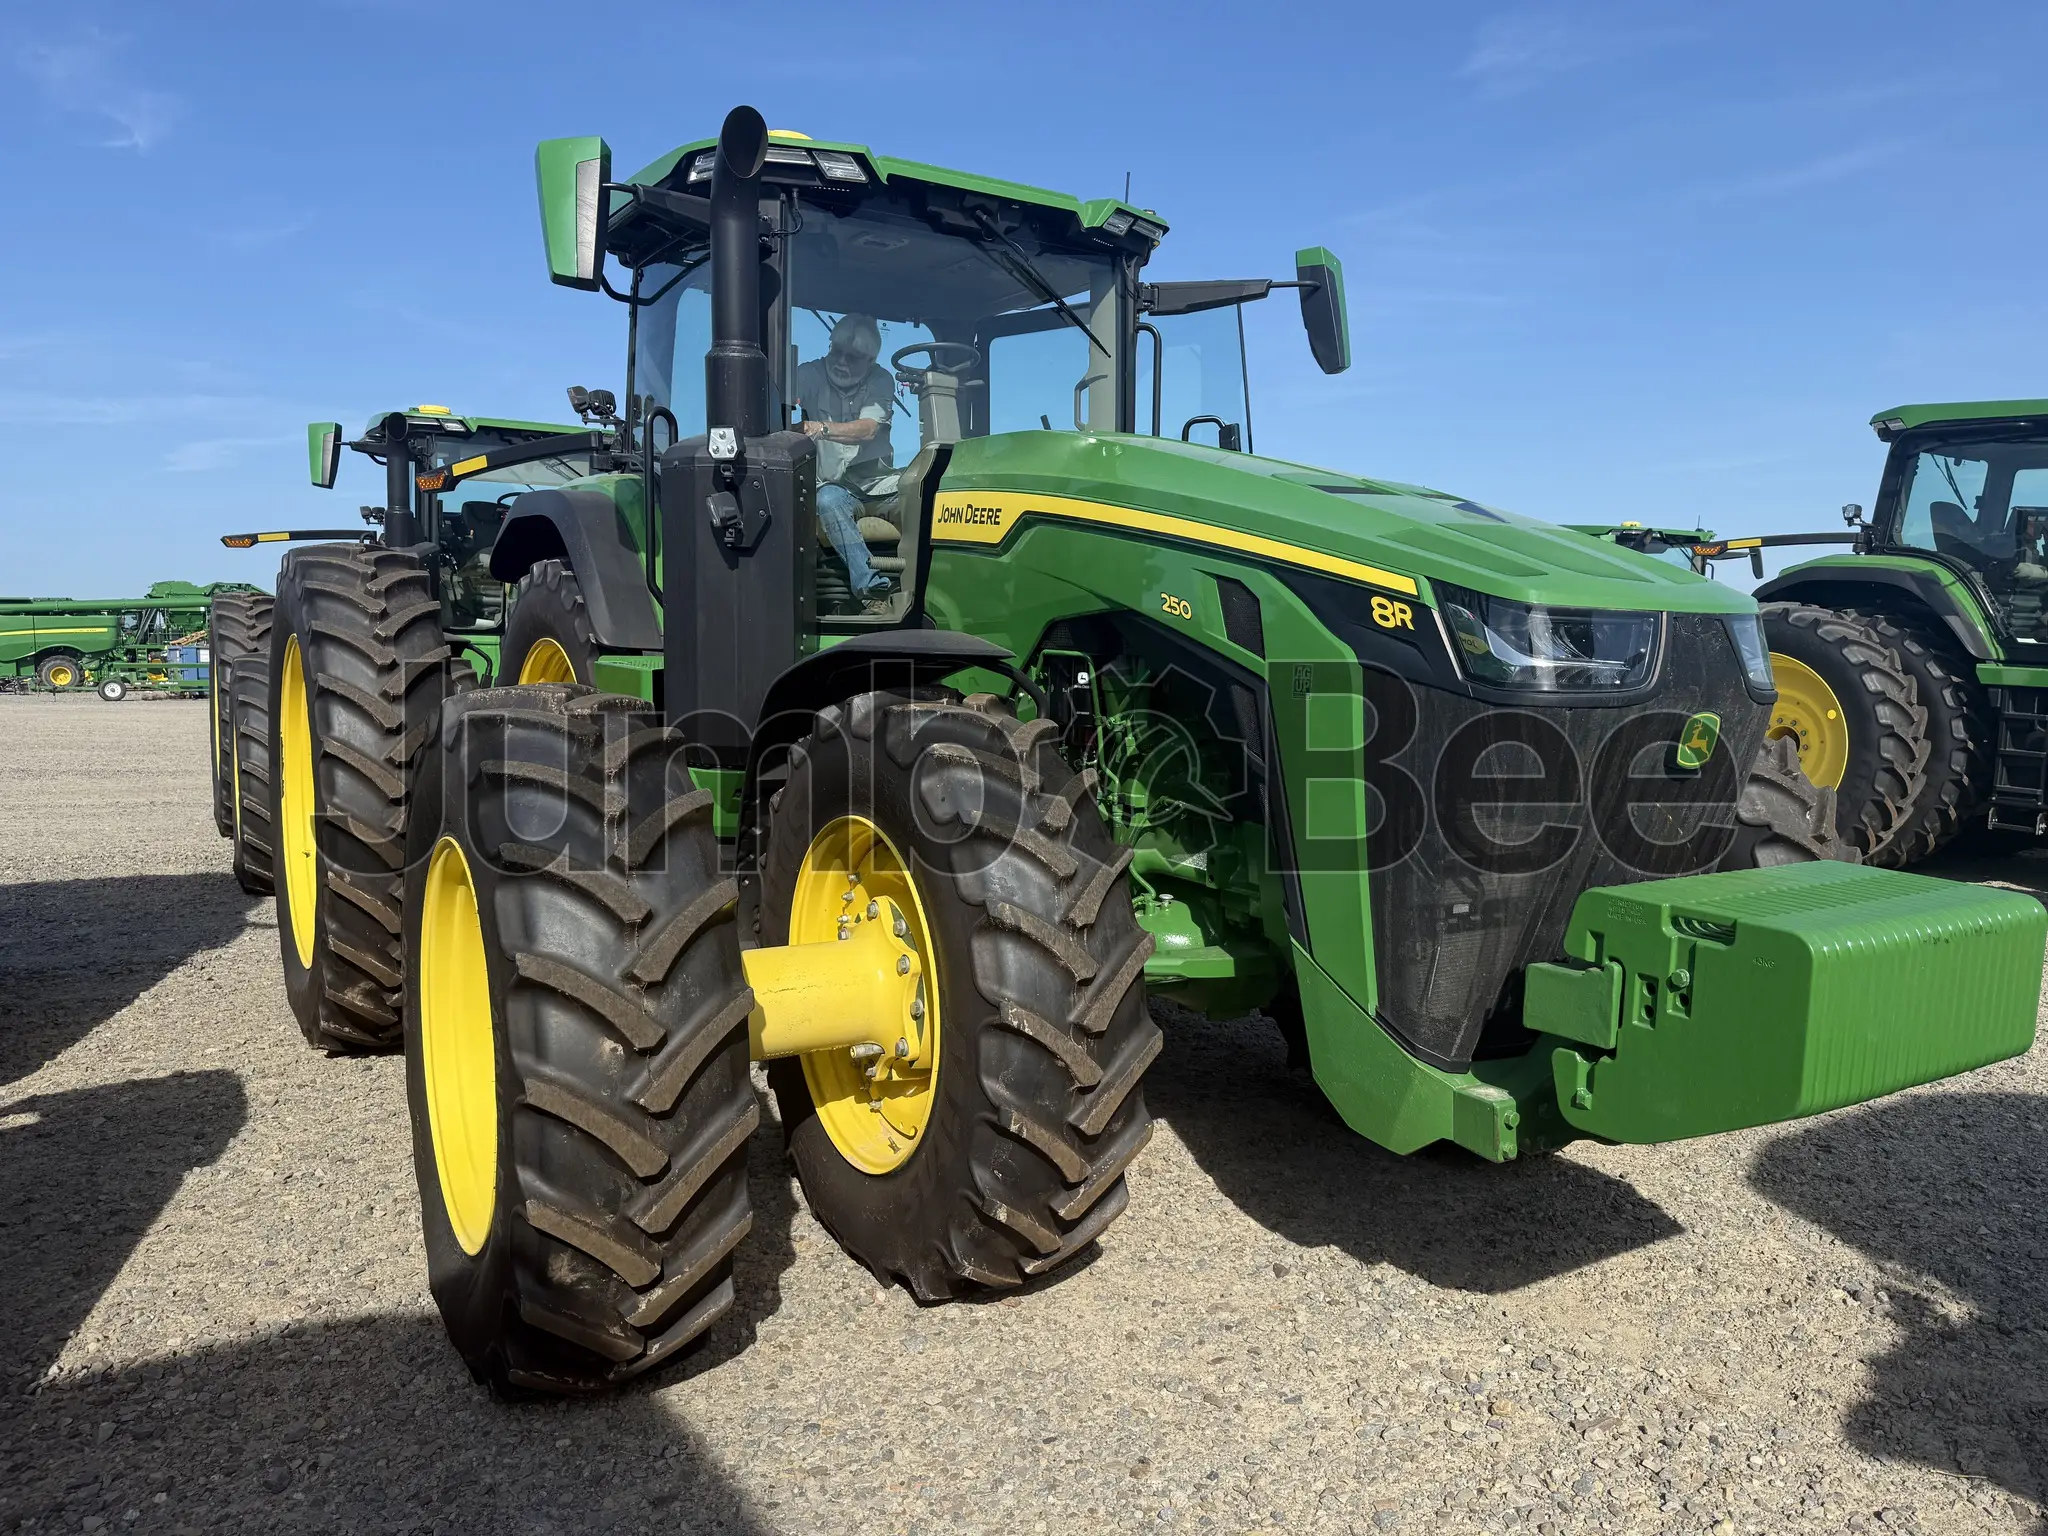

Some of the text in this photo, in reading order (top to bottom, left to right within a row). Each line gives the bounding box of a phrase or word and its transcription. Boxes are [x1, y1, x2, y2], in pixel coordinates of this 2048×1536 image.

[937, 504, 1002, 525] JOHN DEERE
[1160, 592, 1192, 620] 250
[1370, 596, 1415, 631] 8R
